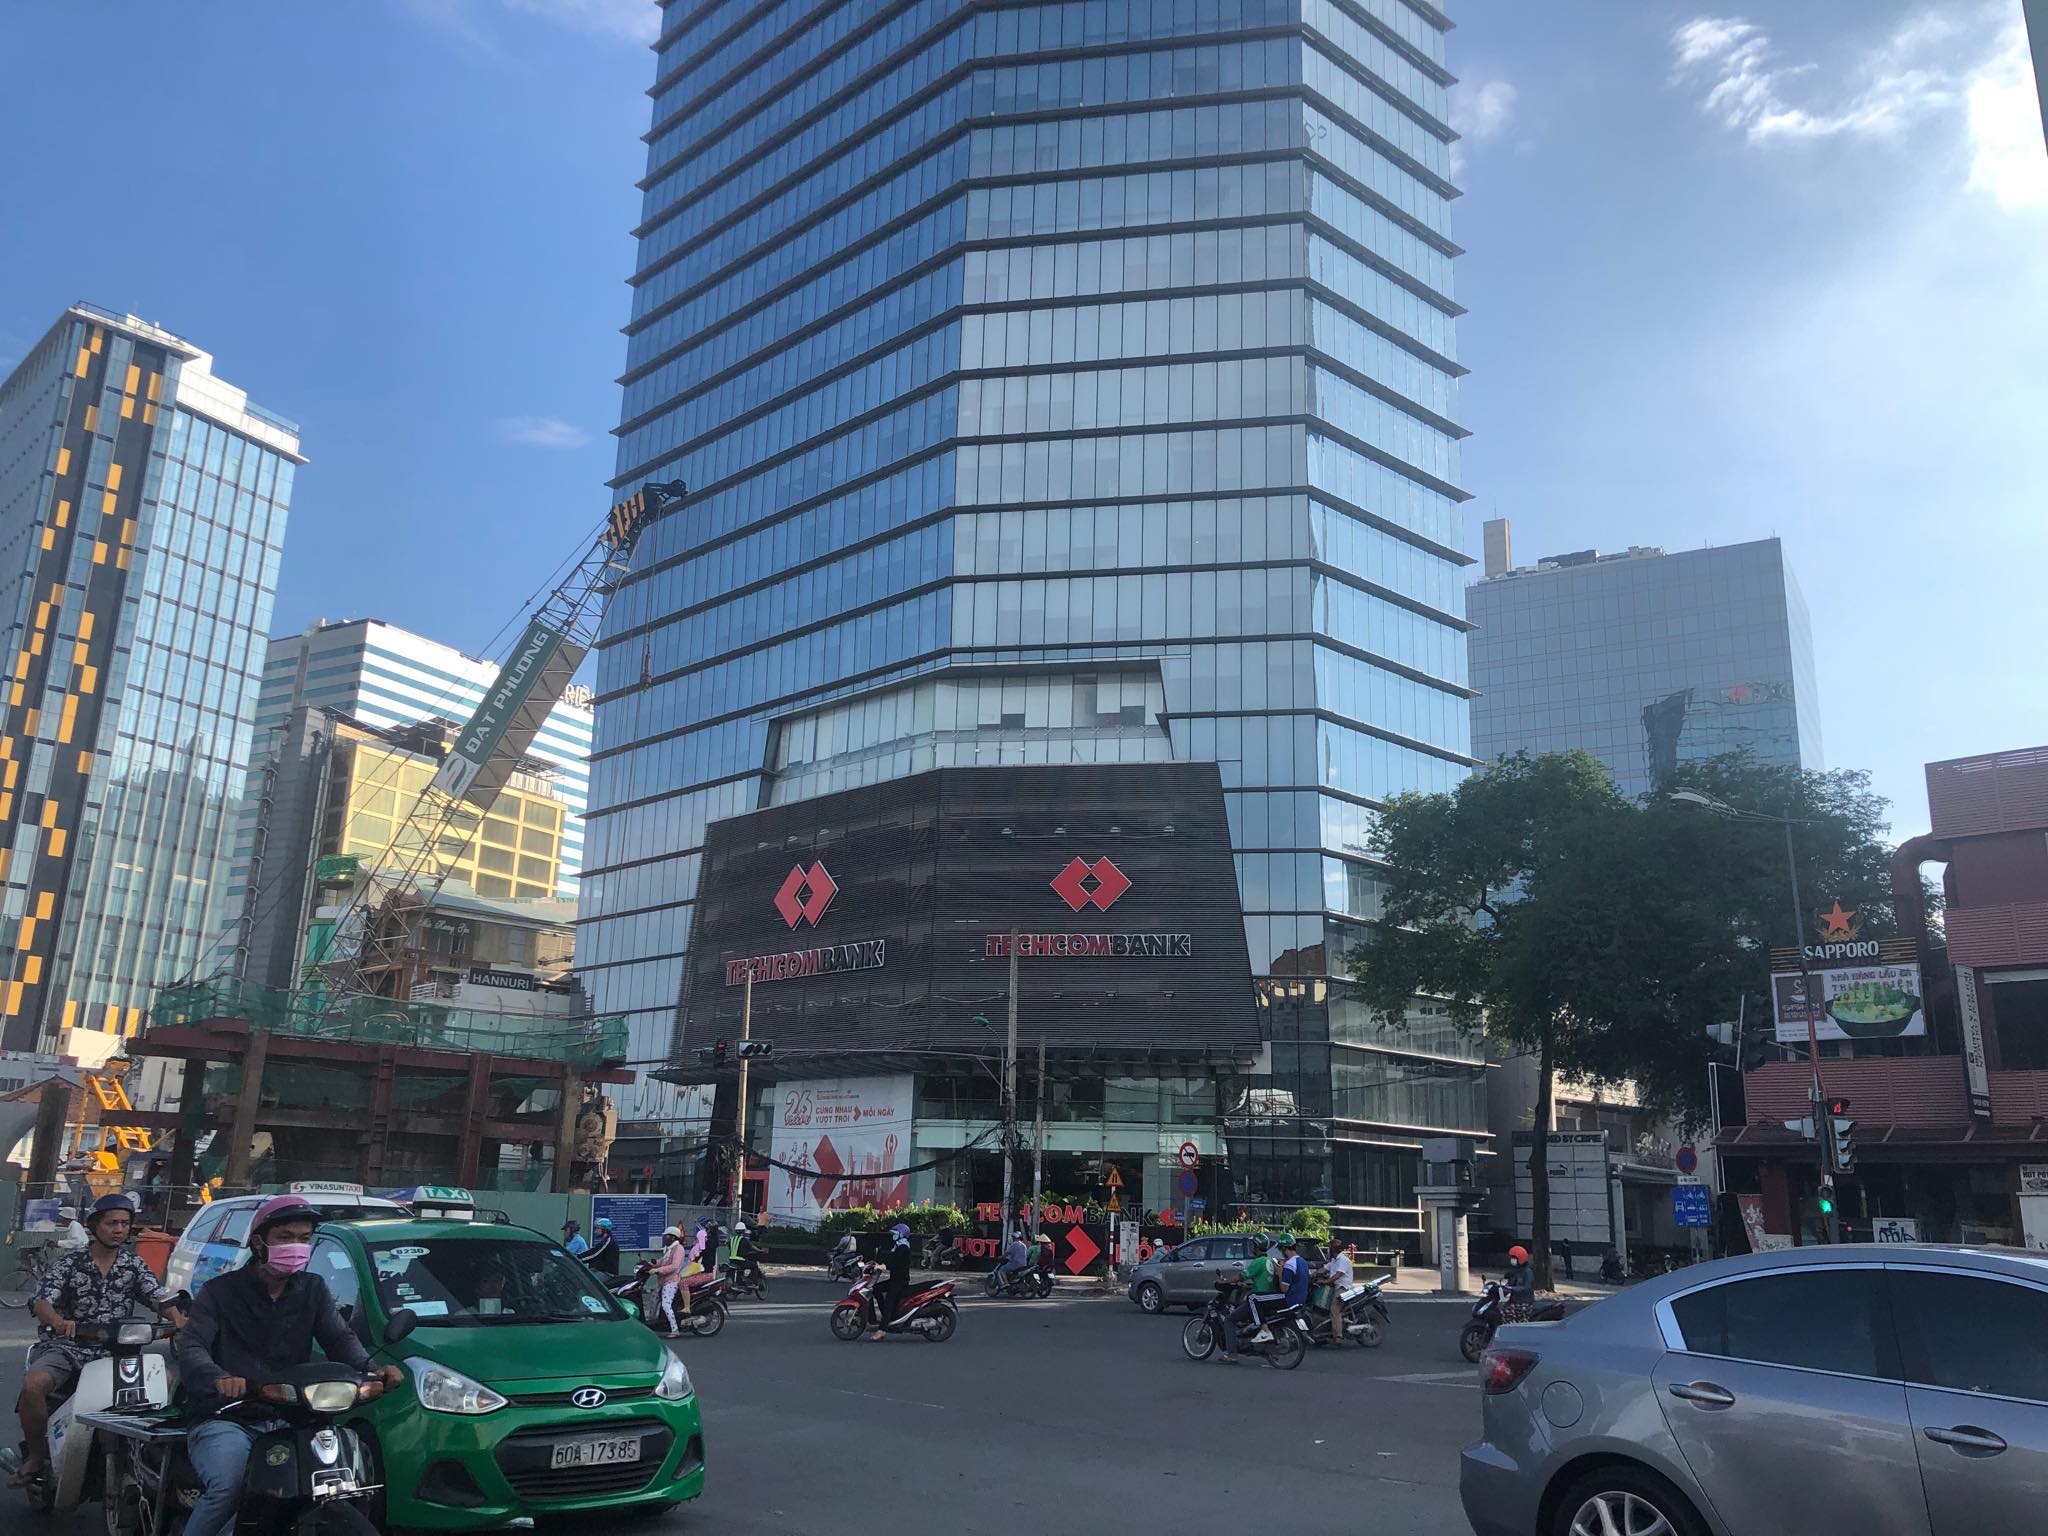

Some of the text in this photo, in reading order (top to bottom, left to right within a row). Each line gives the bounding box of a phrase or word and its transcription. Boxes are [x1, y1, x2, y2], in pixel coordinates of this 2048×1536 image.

[986, 934, 1191, 956] TECHCOMBANK
[1802, 940, 1880, 961] SAPPORO
[726, 939, 885, 985] TECHCOMBANK
[472, 973, 530, 989] HANNURI
[428, 1187, 469, 1200] TAXI
[395, 1247, 424, 1255] 8230
